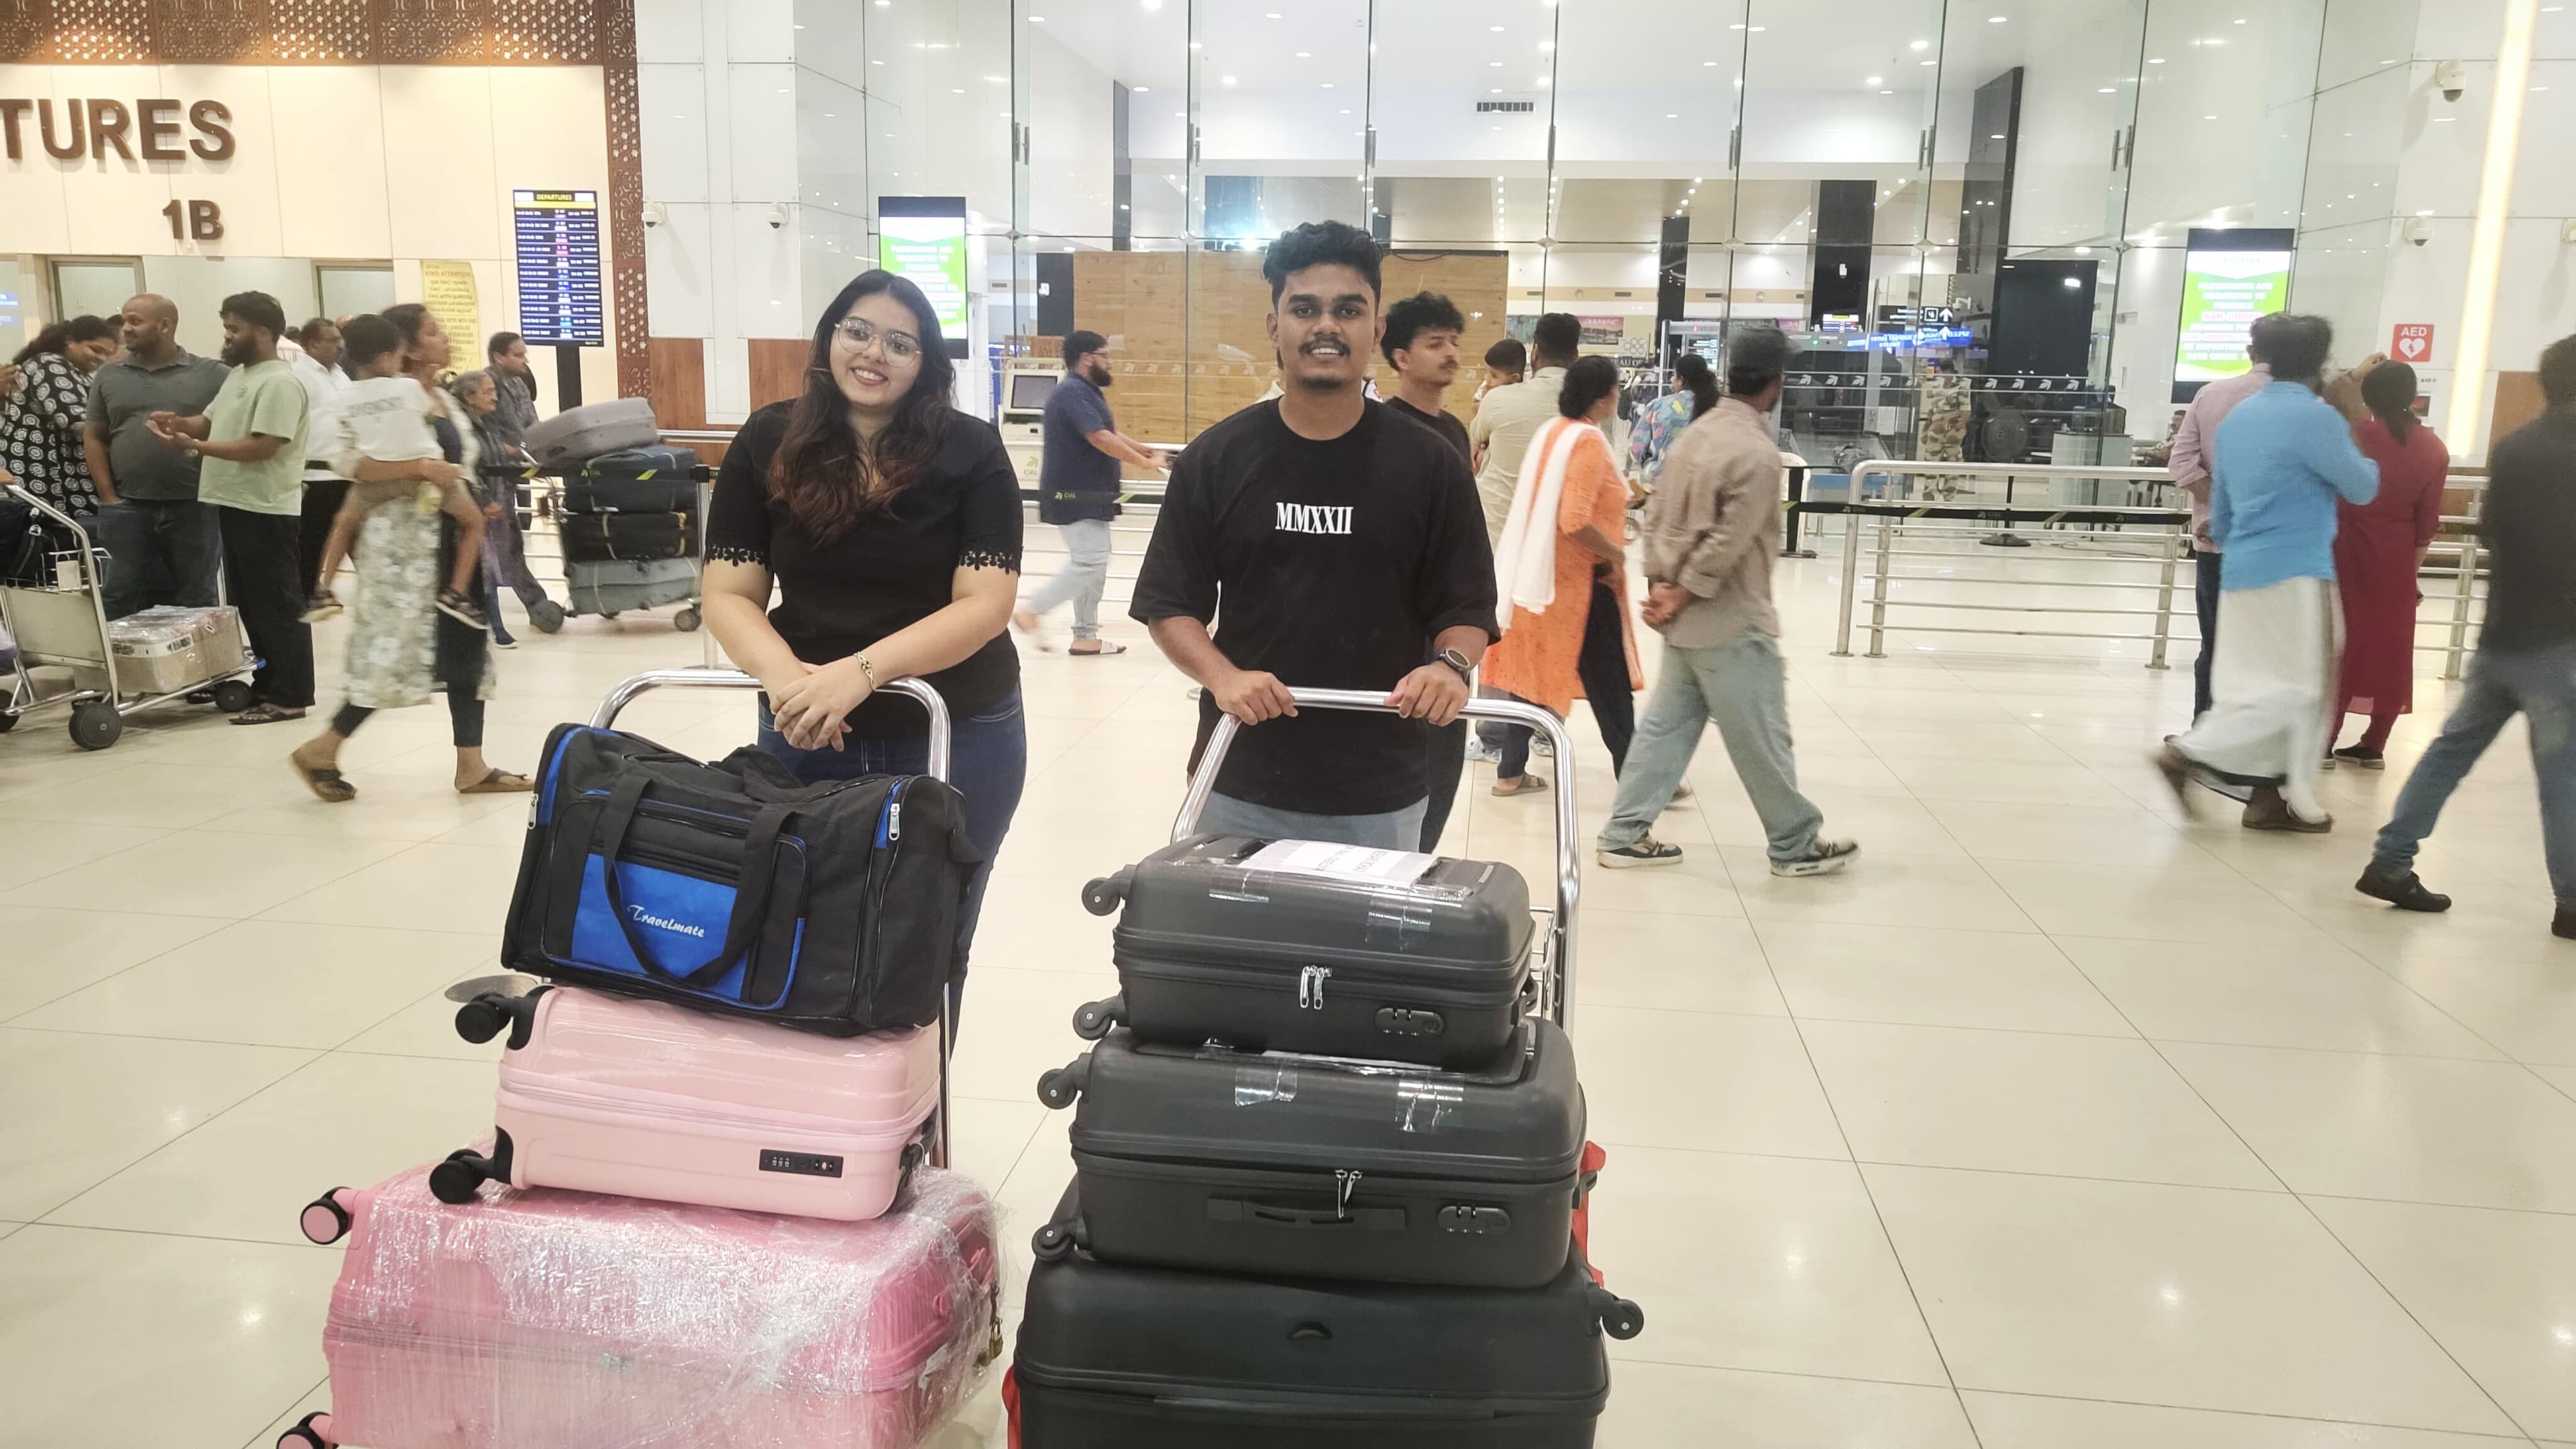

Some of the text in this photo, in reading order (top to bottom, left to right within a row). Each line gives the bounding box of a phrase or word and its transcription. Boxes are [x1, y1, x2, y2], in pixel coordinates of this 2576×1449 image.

[0, 99, 235, 160] TURES
[162, 199, 224, 239] 1B
[2400, 327, 2427, 337] AED
[1275, 502, 1354, 535] MMXXII
[627, 904, 705, 938] Travelmate
